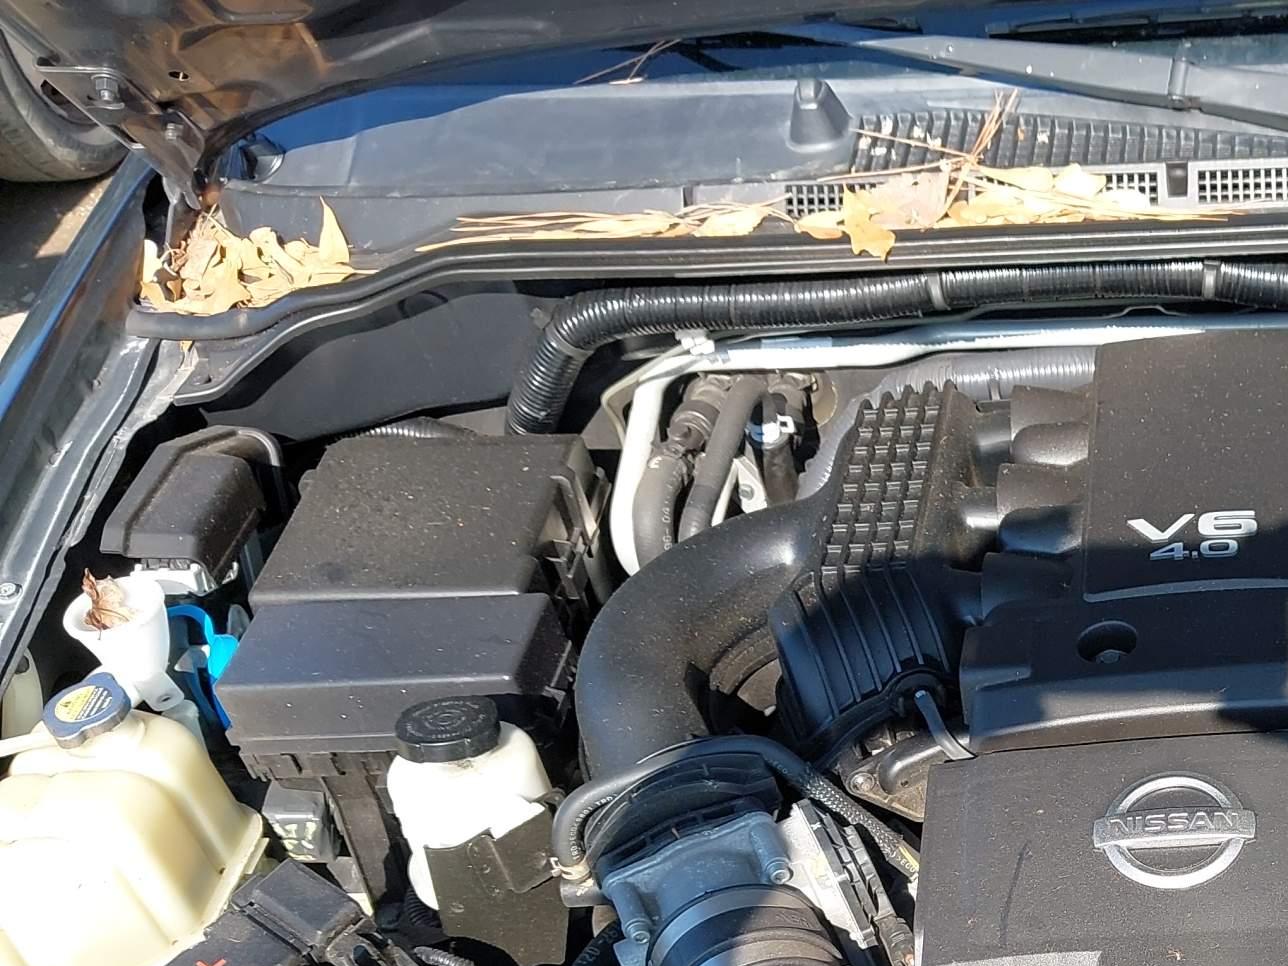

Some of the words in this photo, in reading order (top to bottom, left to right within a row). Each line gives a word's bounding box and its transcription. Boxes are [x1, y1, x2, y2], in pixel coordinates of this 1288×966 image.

[1126, 510, 1258, 543] V6
[1150, 539, 1238, 560] 4.0
[1109, 811, 1240, 834] NISSAN
